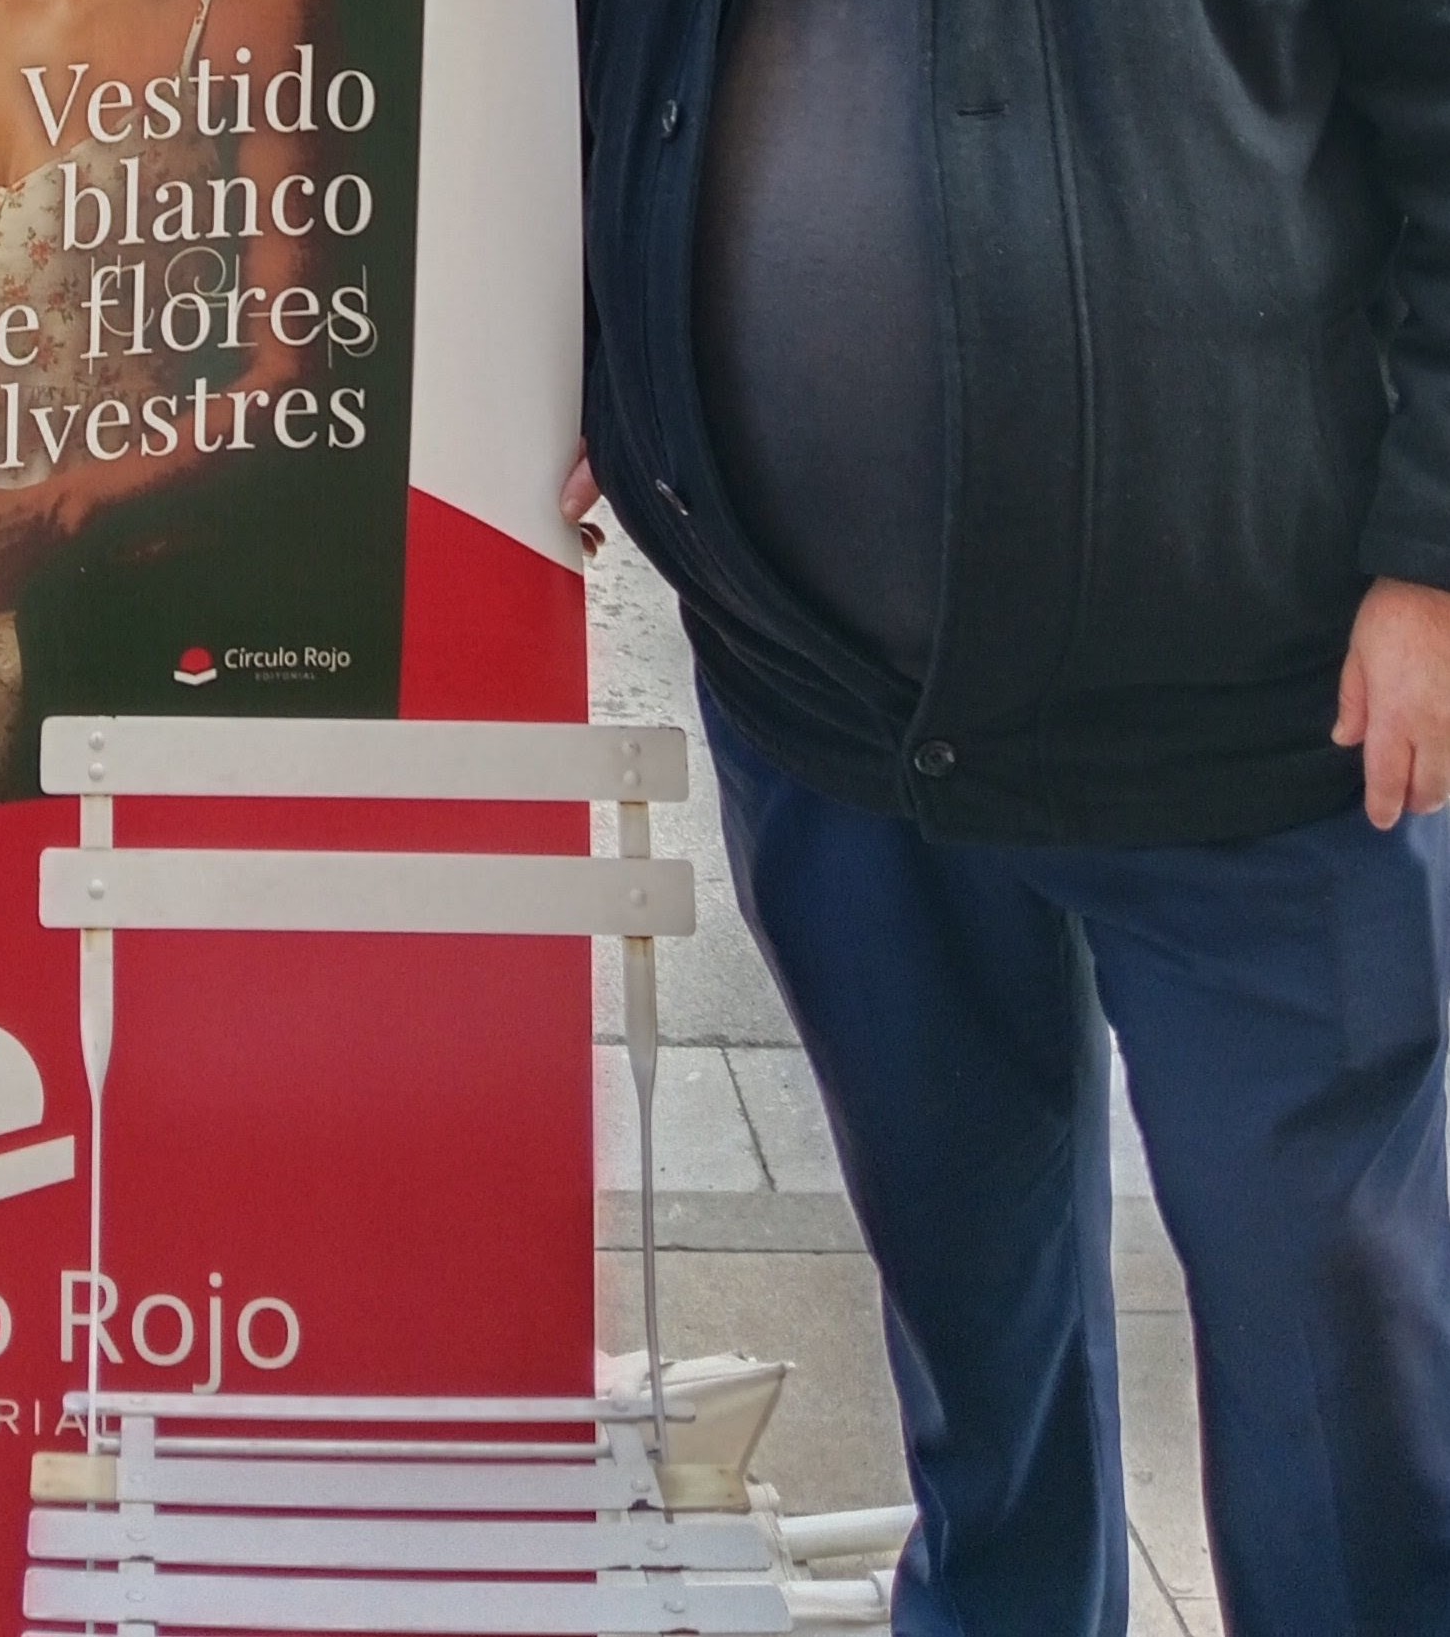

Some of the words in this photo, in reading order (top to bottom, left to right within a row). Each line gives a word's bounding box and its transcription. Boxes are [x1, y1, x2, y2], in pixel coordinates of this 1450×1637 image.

[20, 44, 377, 146] Vestido
[58, 157, 373, 251] blanco
[81, 248, 378, 372] flores
[304, 646, 351, 673] Rojo
[60, 1269, 300, 1396] Rojo
